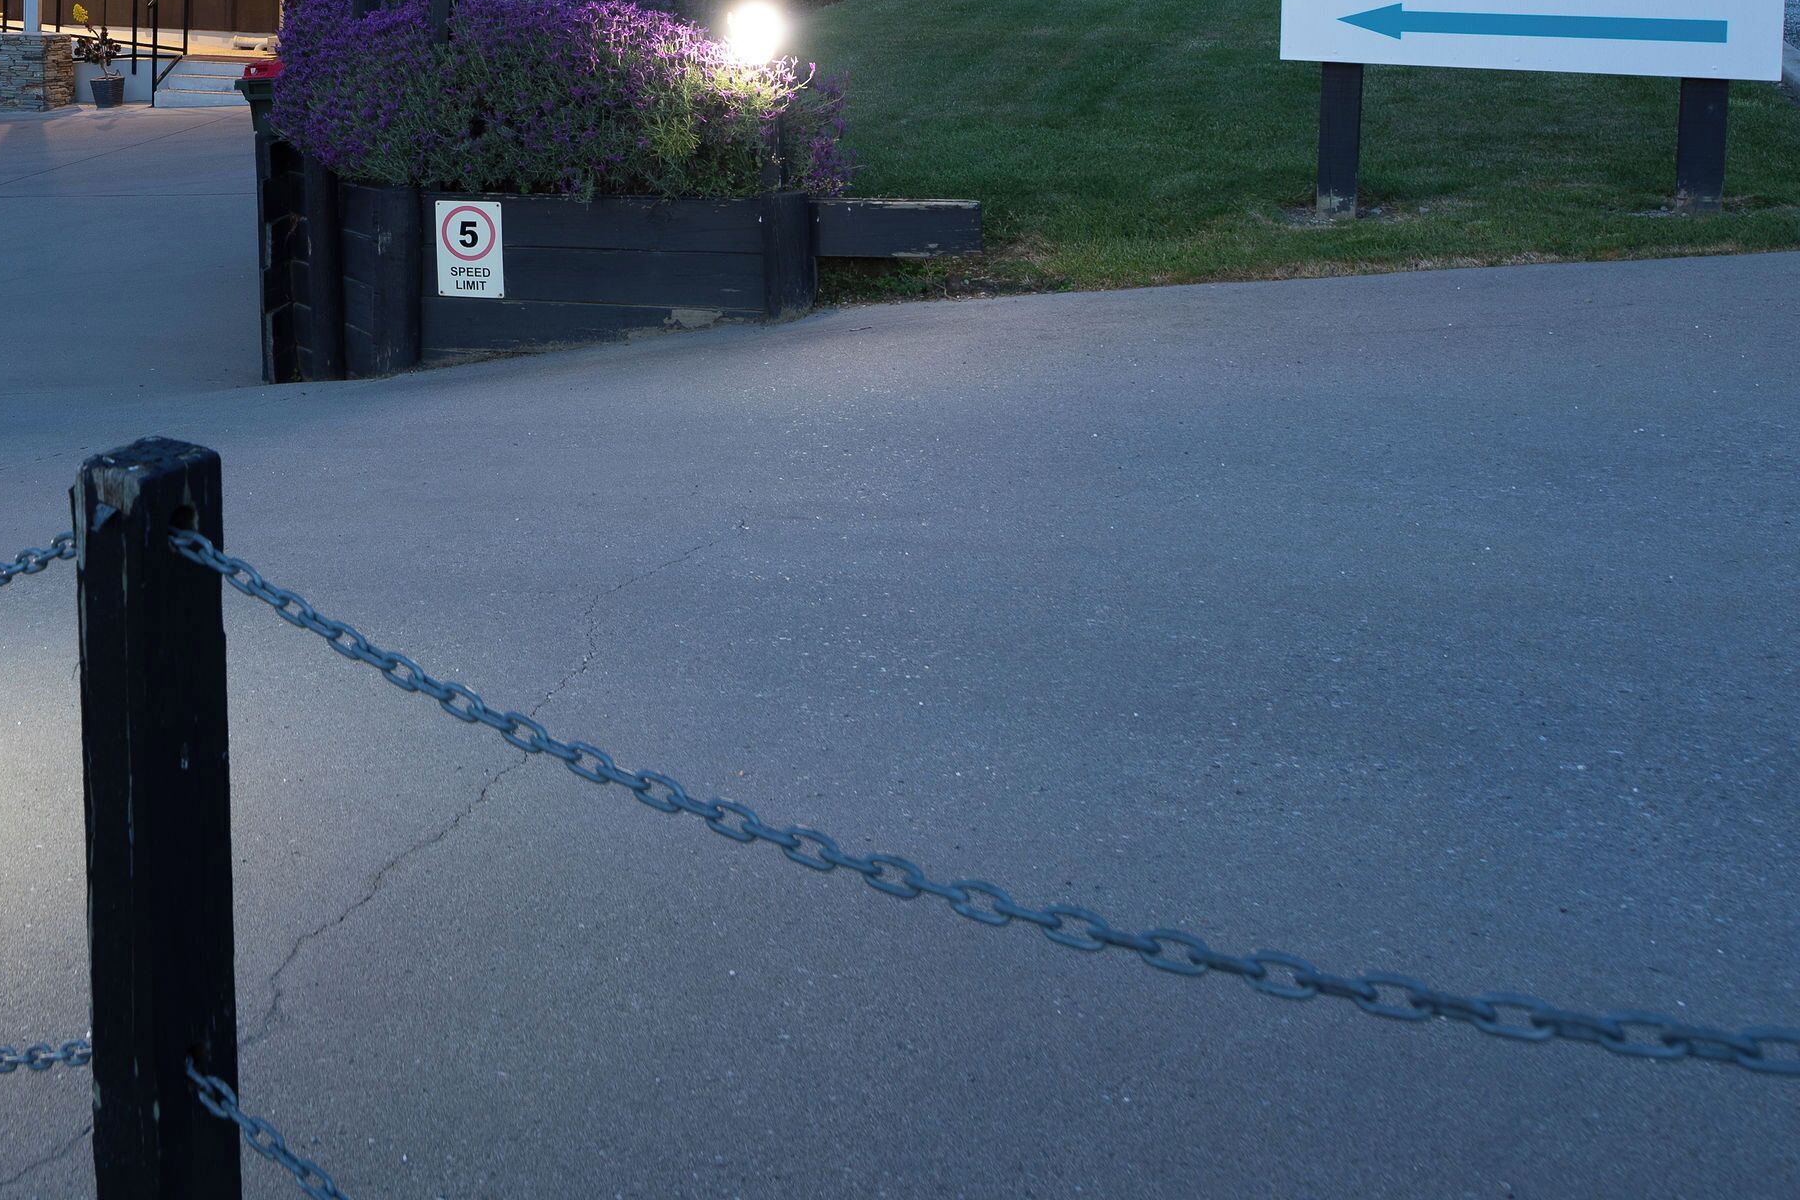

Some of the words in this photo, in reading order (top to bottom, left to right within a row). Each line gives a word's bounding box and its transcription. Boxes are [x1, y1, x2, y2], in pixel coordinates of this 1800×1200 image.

[458, 220, 479, 248] 5
[450, 266, 491, 278] SPEED
[455, 280, 487, 291] LIMIT
